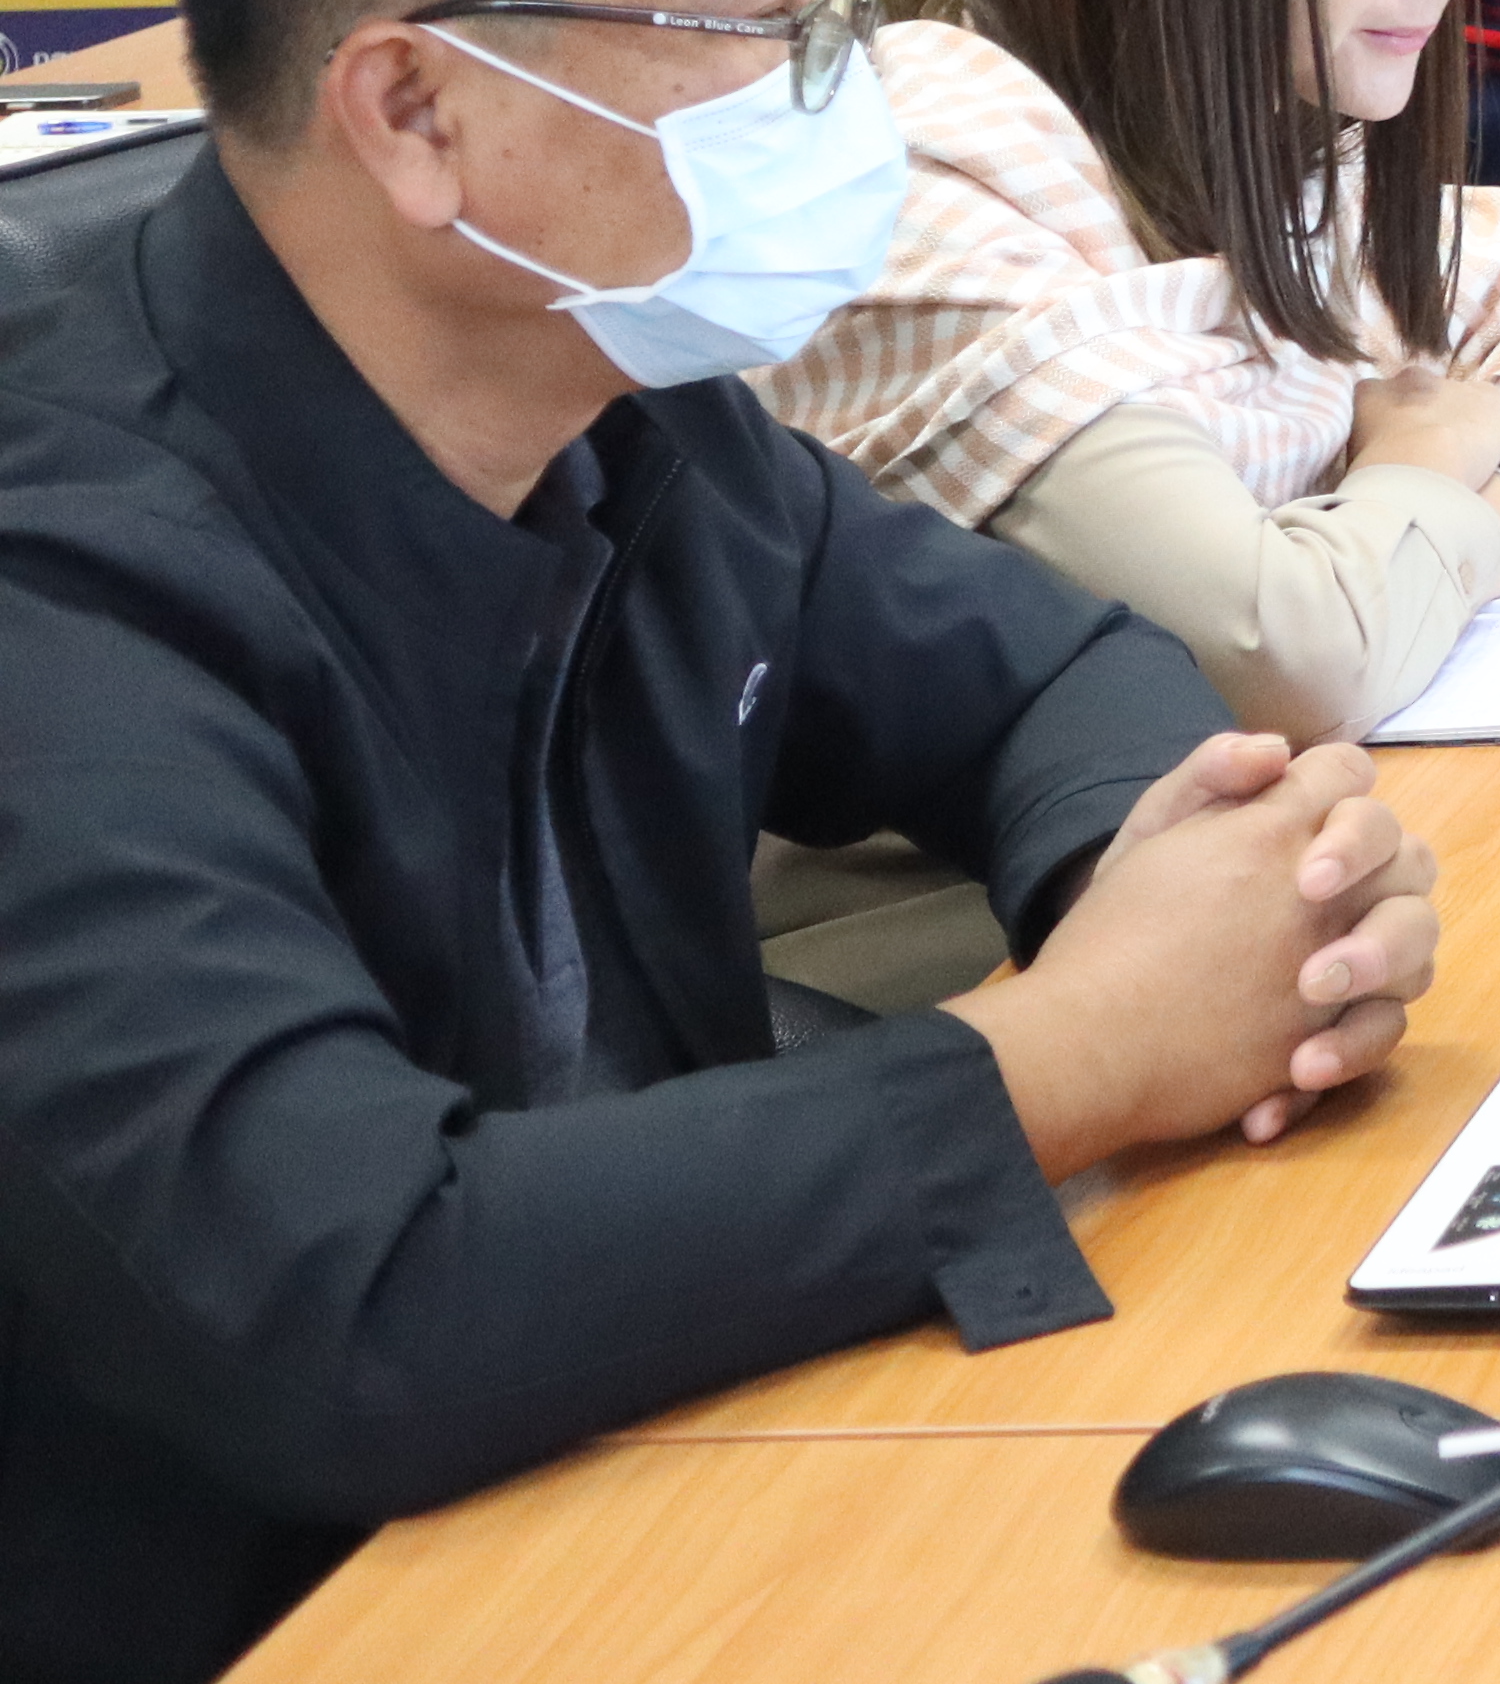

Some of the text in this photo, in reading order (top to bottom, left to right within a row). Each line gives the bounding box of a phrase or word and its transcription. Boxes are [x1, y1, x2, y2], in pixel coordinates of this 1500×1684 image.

[669, 15, 765, 35] Leon Blue Care
